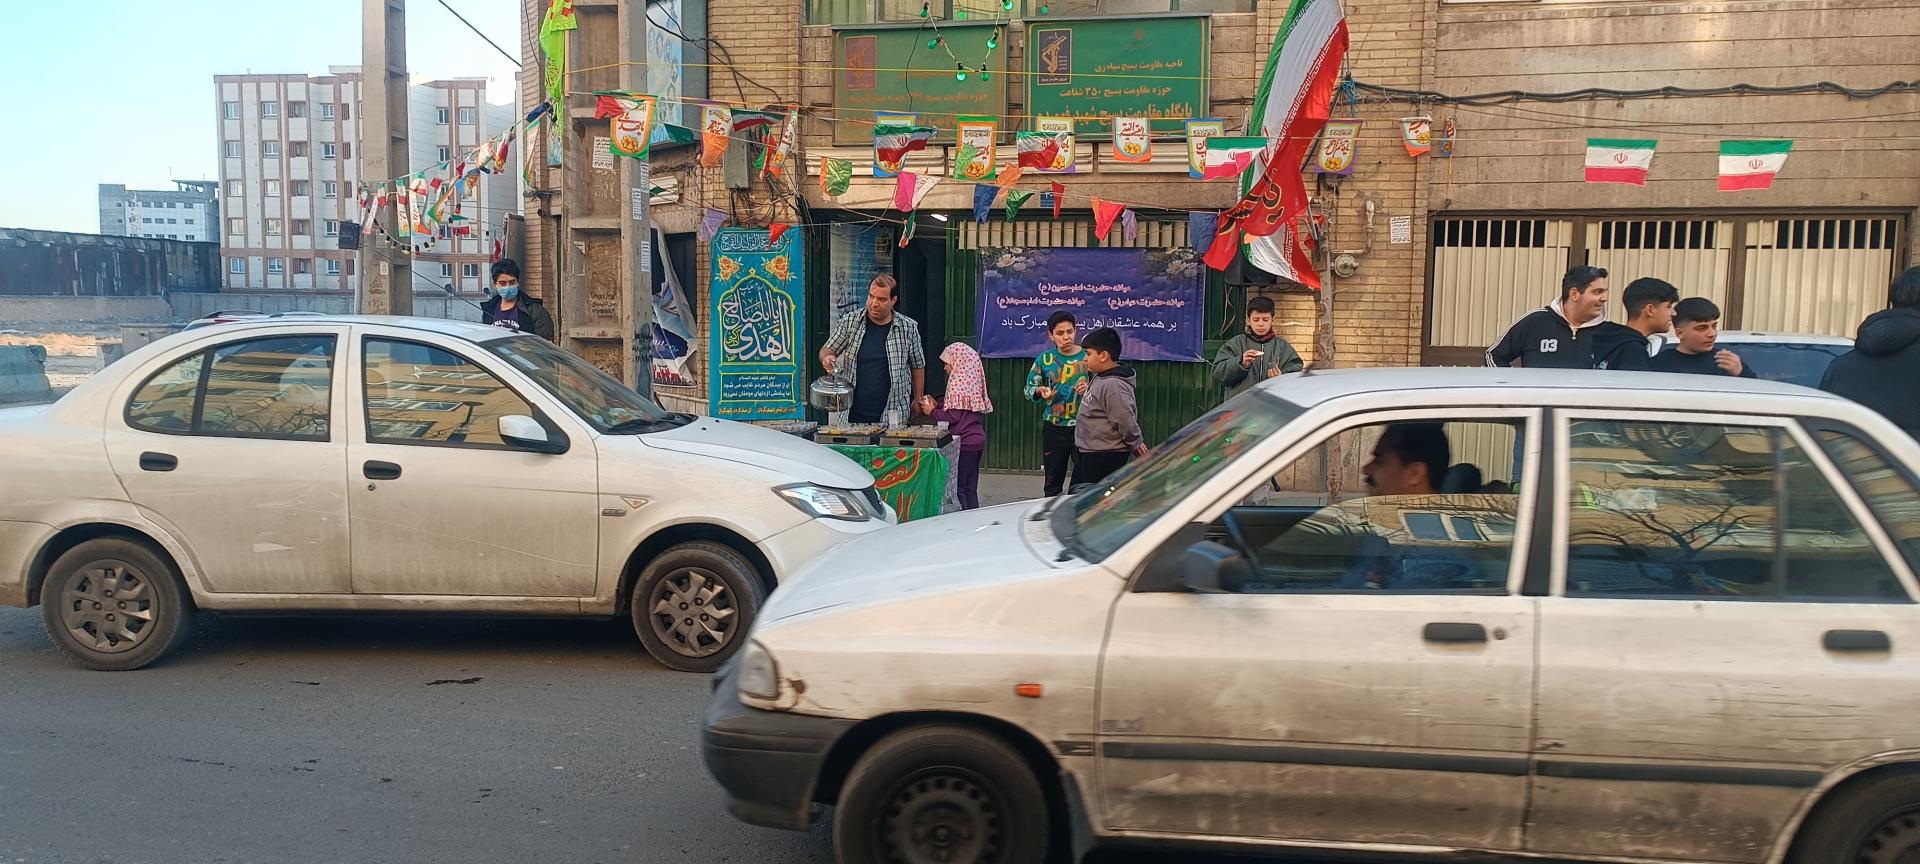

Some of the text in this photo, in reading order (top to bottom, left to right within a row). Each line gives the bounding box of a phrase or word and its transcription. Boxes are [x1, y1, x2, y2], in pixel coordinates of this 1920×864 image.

[1121, 63, 1138, 72] بسیج
[1139, 60, 1163, 71] مقاومت
[1165, 59, 1183, 70] ناحیه
[1058, 85, 1172, 98] حوزه مقاومت بسیج ۳۵۰ شفاعت
[1001, 314, 1177, 332] بر همه عاشقان اهل بی مبارک باد
[1540, 338, 1559, 353] 03
